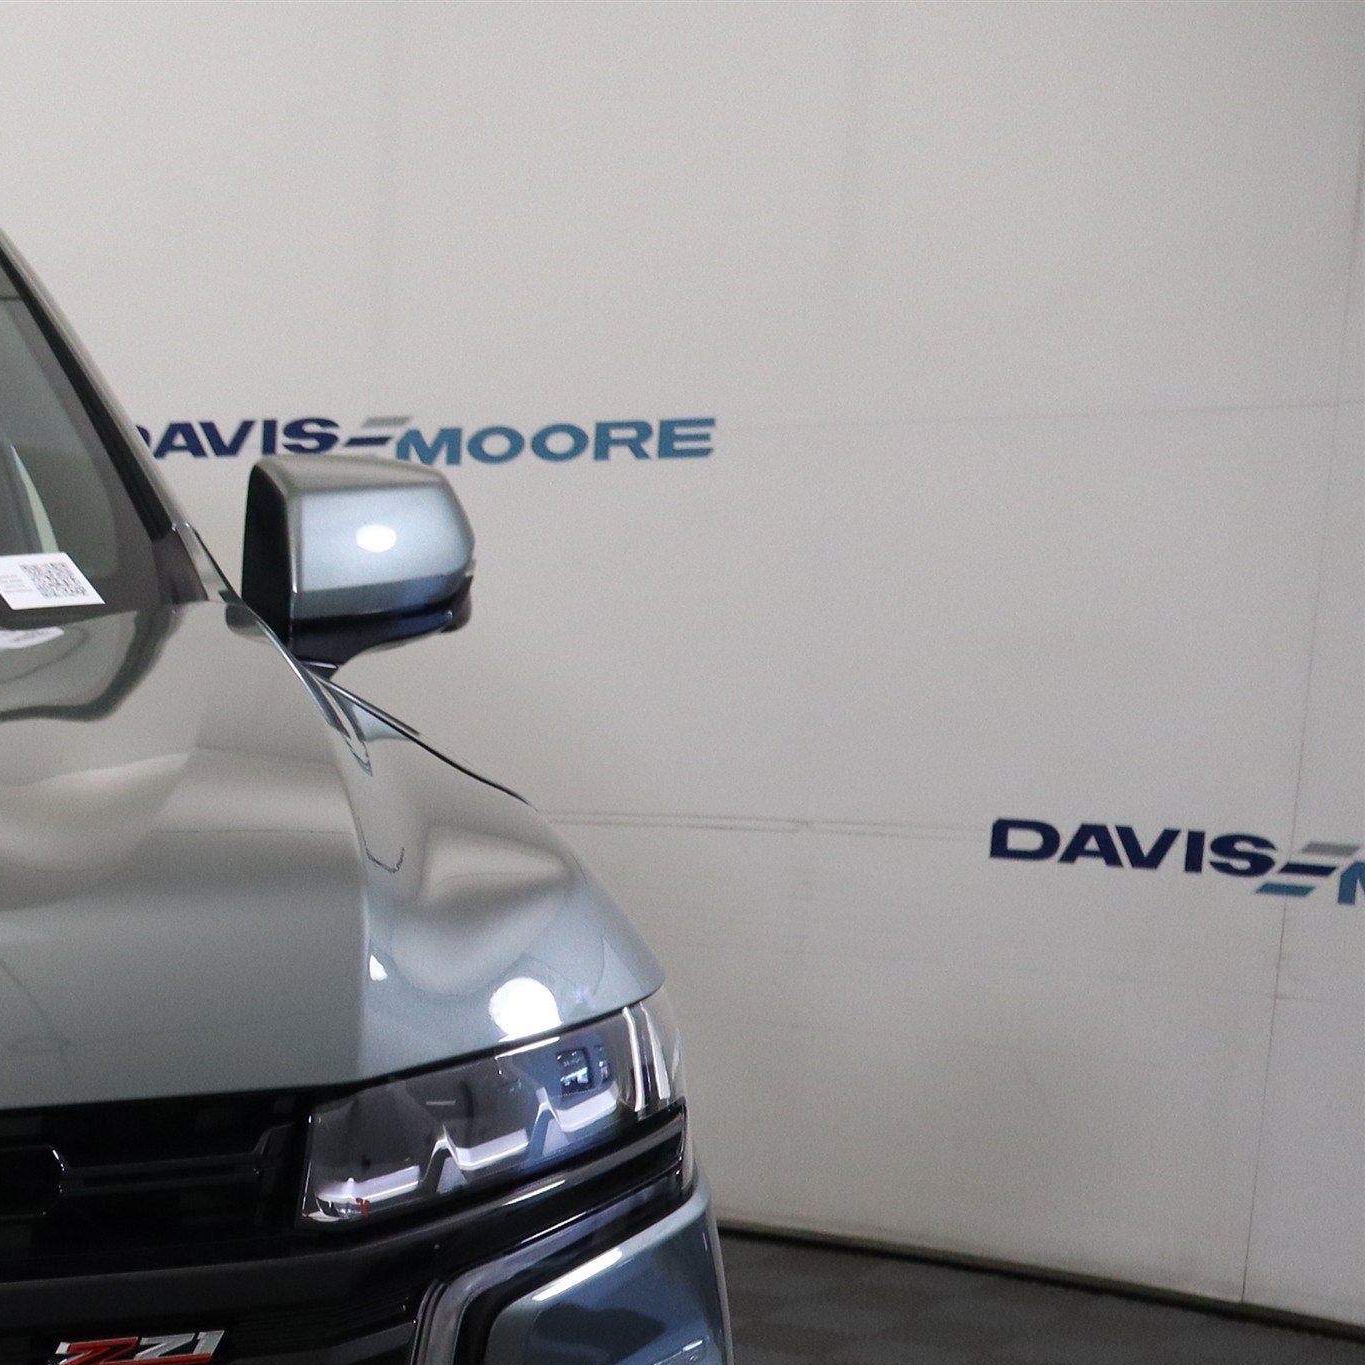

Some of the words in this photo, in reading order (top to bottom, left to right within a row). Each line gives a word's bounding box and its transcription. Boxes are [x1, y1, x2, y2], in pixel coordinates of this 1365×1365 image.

[136, 418, 339, 458] AVIS
[395, 418, 716, 465] MOORE
[990, 818, 1277, 877] DAVIS
